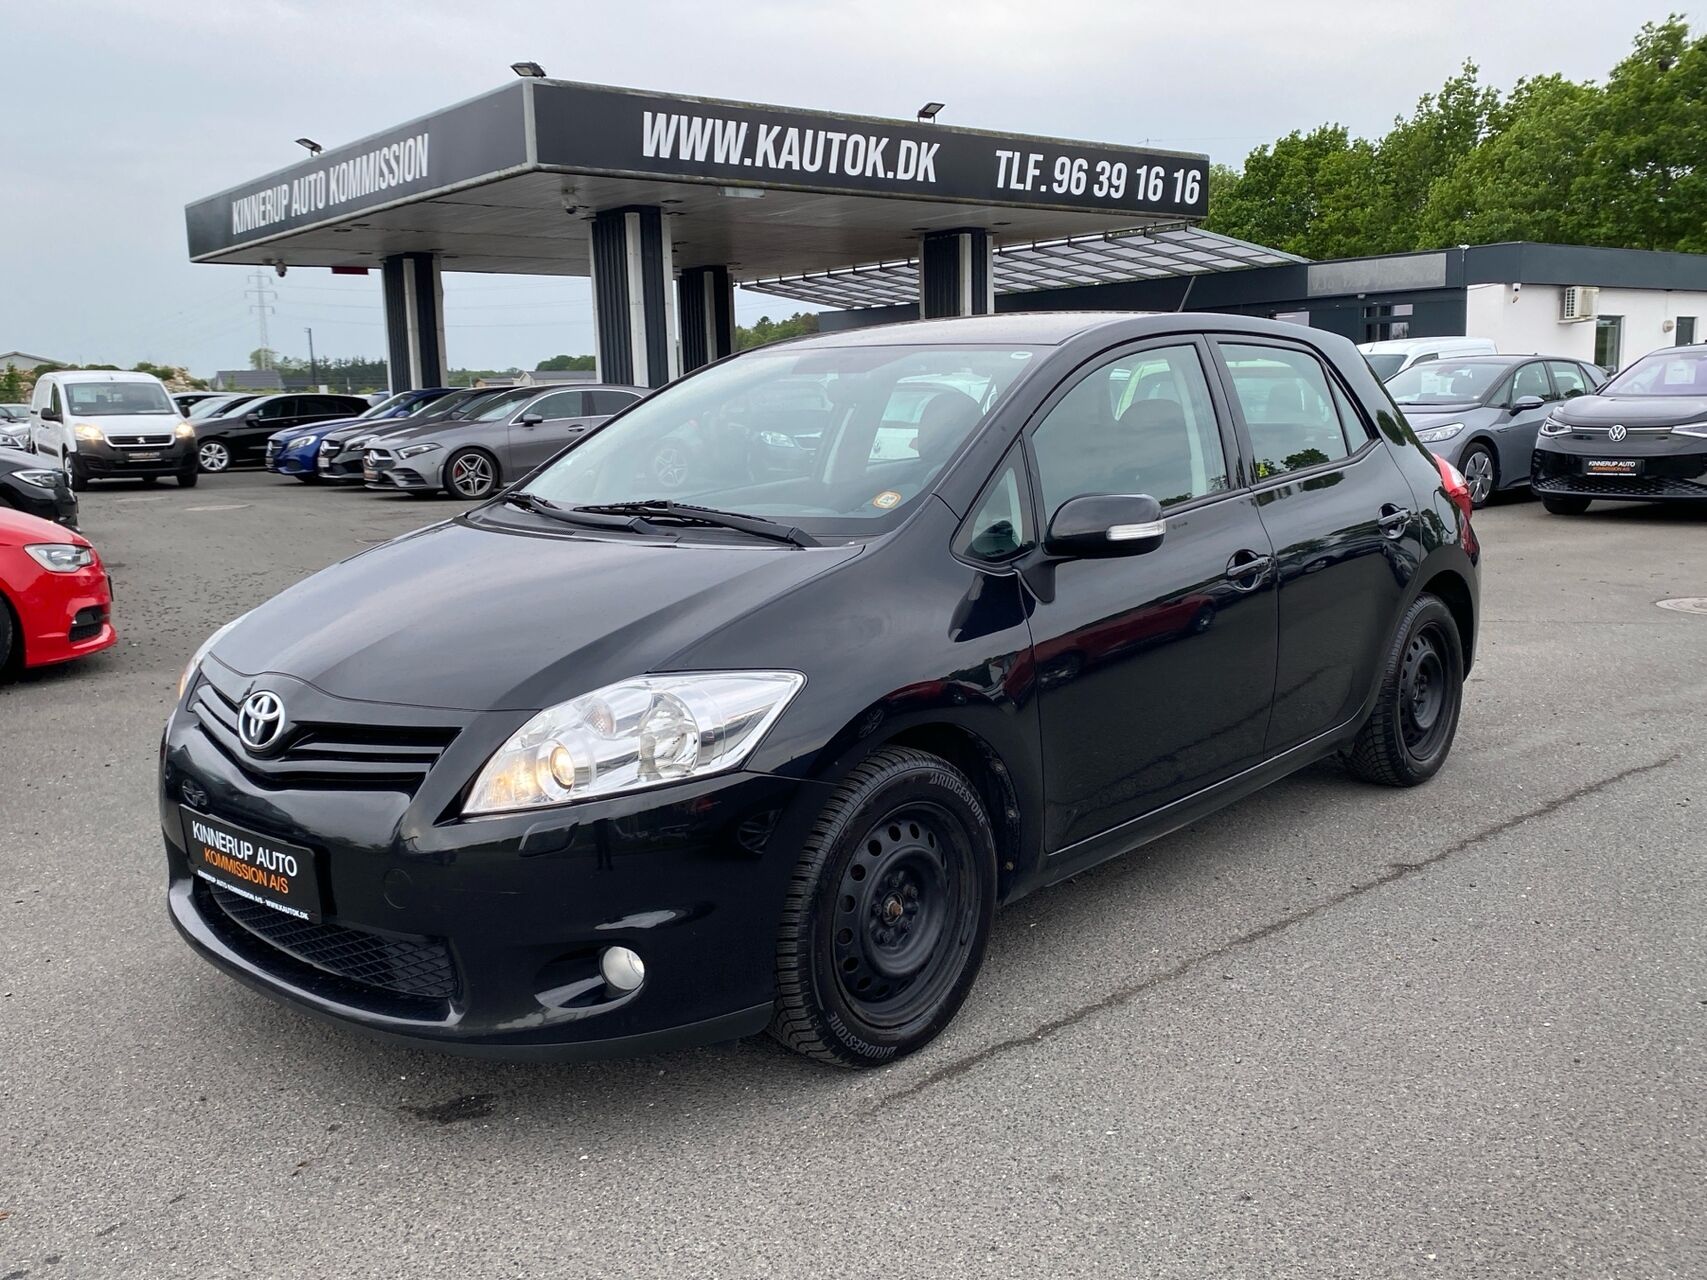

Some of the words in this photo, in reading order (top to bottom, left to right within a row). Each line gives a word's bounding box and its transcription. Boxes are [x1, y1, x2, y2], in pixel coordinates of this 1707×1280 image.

[642, 111, 941, 183] WWW.KAUTOK.DK
[232, 183, 290, 235] KINNERUP
[291, 170, 326, 217] AUTO
[329, 133, 429, 206] KOMMISSION
[995, 150, 1047, 192] TLF.
[1052, 156, 1089, 196] 96
[1093, 160, 1128, 199] 39
[1136, 165, 1165, 202] 16
[1173, 169, 1202, 205] 16
[928, 772, 987, 827] BRIDGESTONE
[192, 820, 253, 861] KINNERUP
[256, 846, 298, 877] AUTO
[203, 847, 268, 887] KOMMISSION
[828, 1010, 898, 1060] BRIDGESTONE
